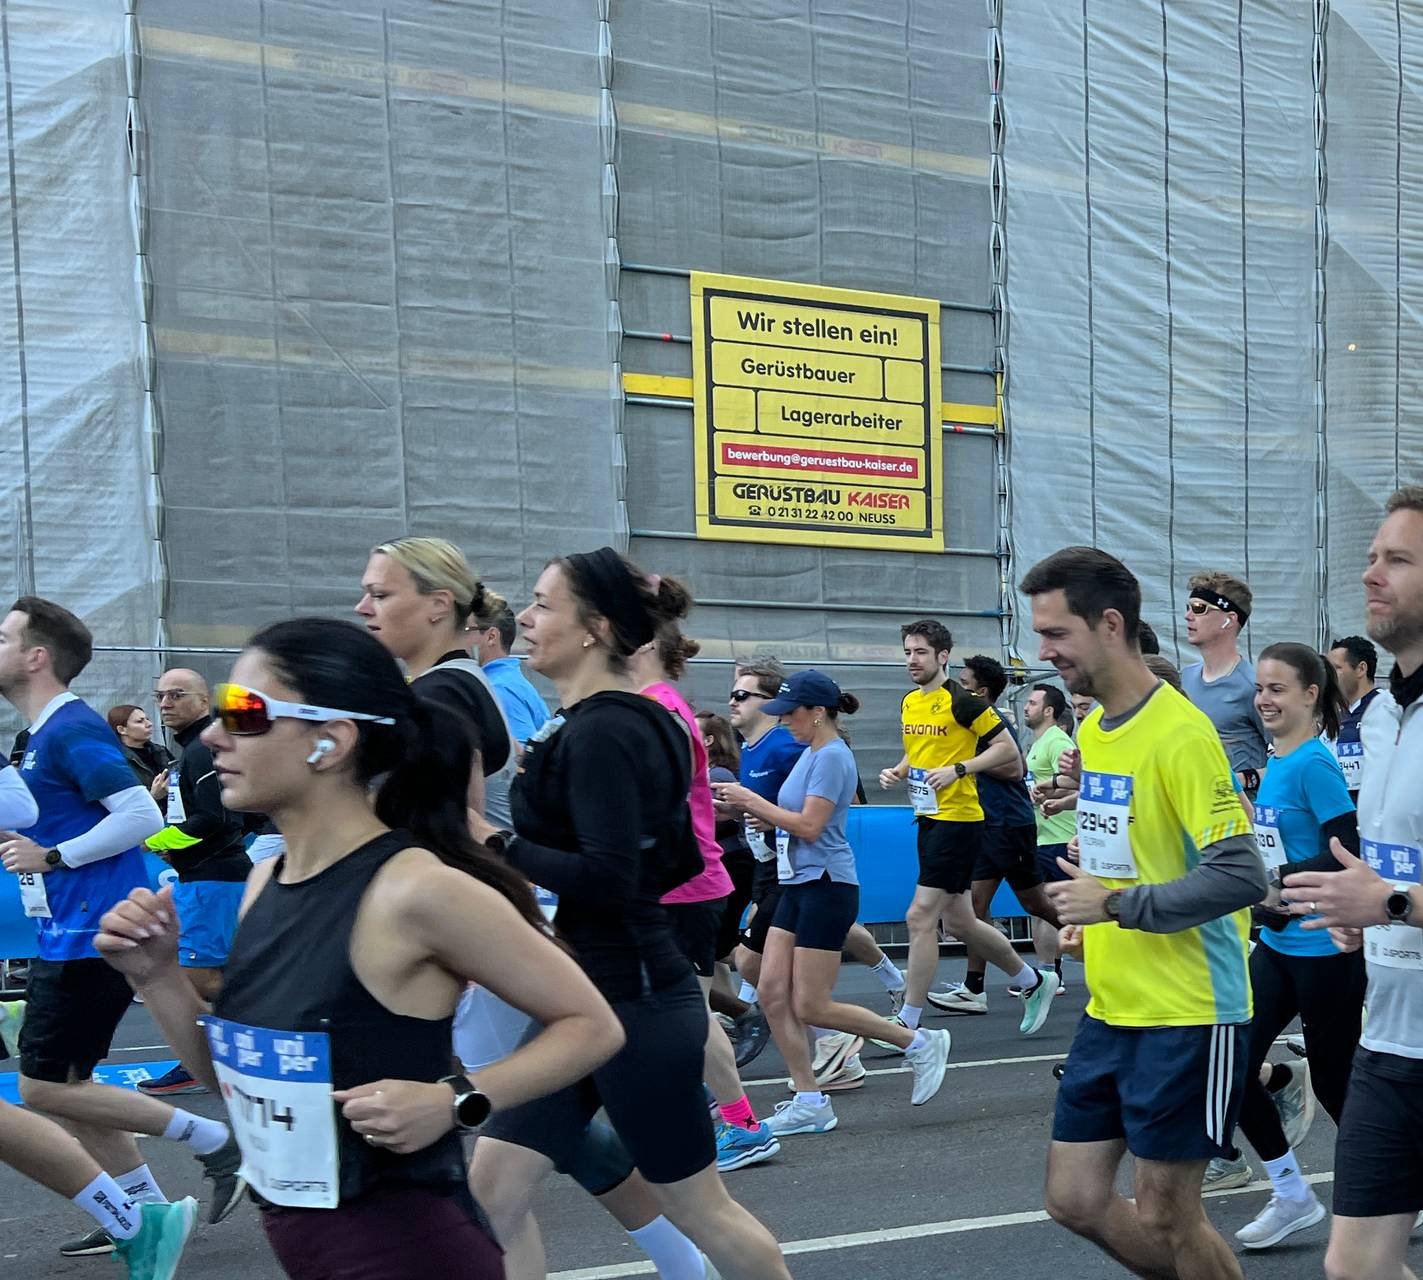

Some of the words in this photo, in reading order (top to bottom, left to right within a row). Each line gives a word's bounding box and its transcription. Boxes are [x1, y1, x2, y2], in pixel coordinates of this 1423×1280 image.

[737, 311, 776, 332] Wir
[783, 318, 853, 341] stellen
[860, 326, 898, 346] ein!
[741, 358, 856, 383] Gerüstbauer
[781, 405, 903, 430] Lagerarbeiter
[727, 448, 913, 473] bewerbung@geruestbau-kaiser.de
[732, 483, 840, 505] GERÜSTBAU
[848, 491, 910, 510] KAISER
[859, 513, 896, 524] NEUSS
[904, 724, 948, 736] EVONIK
